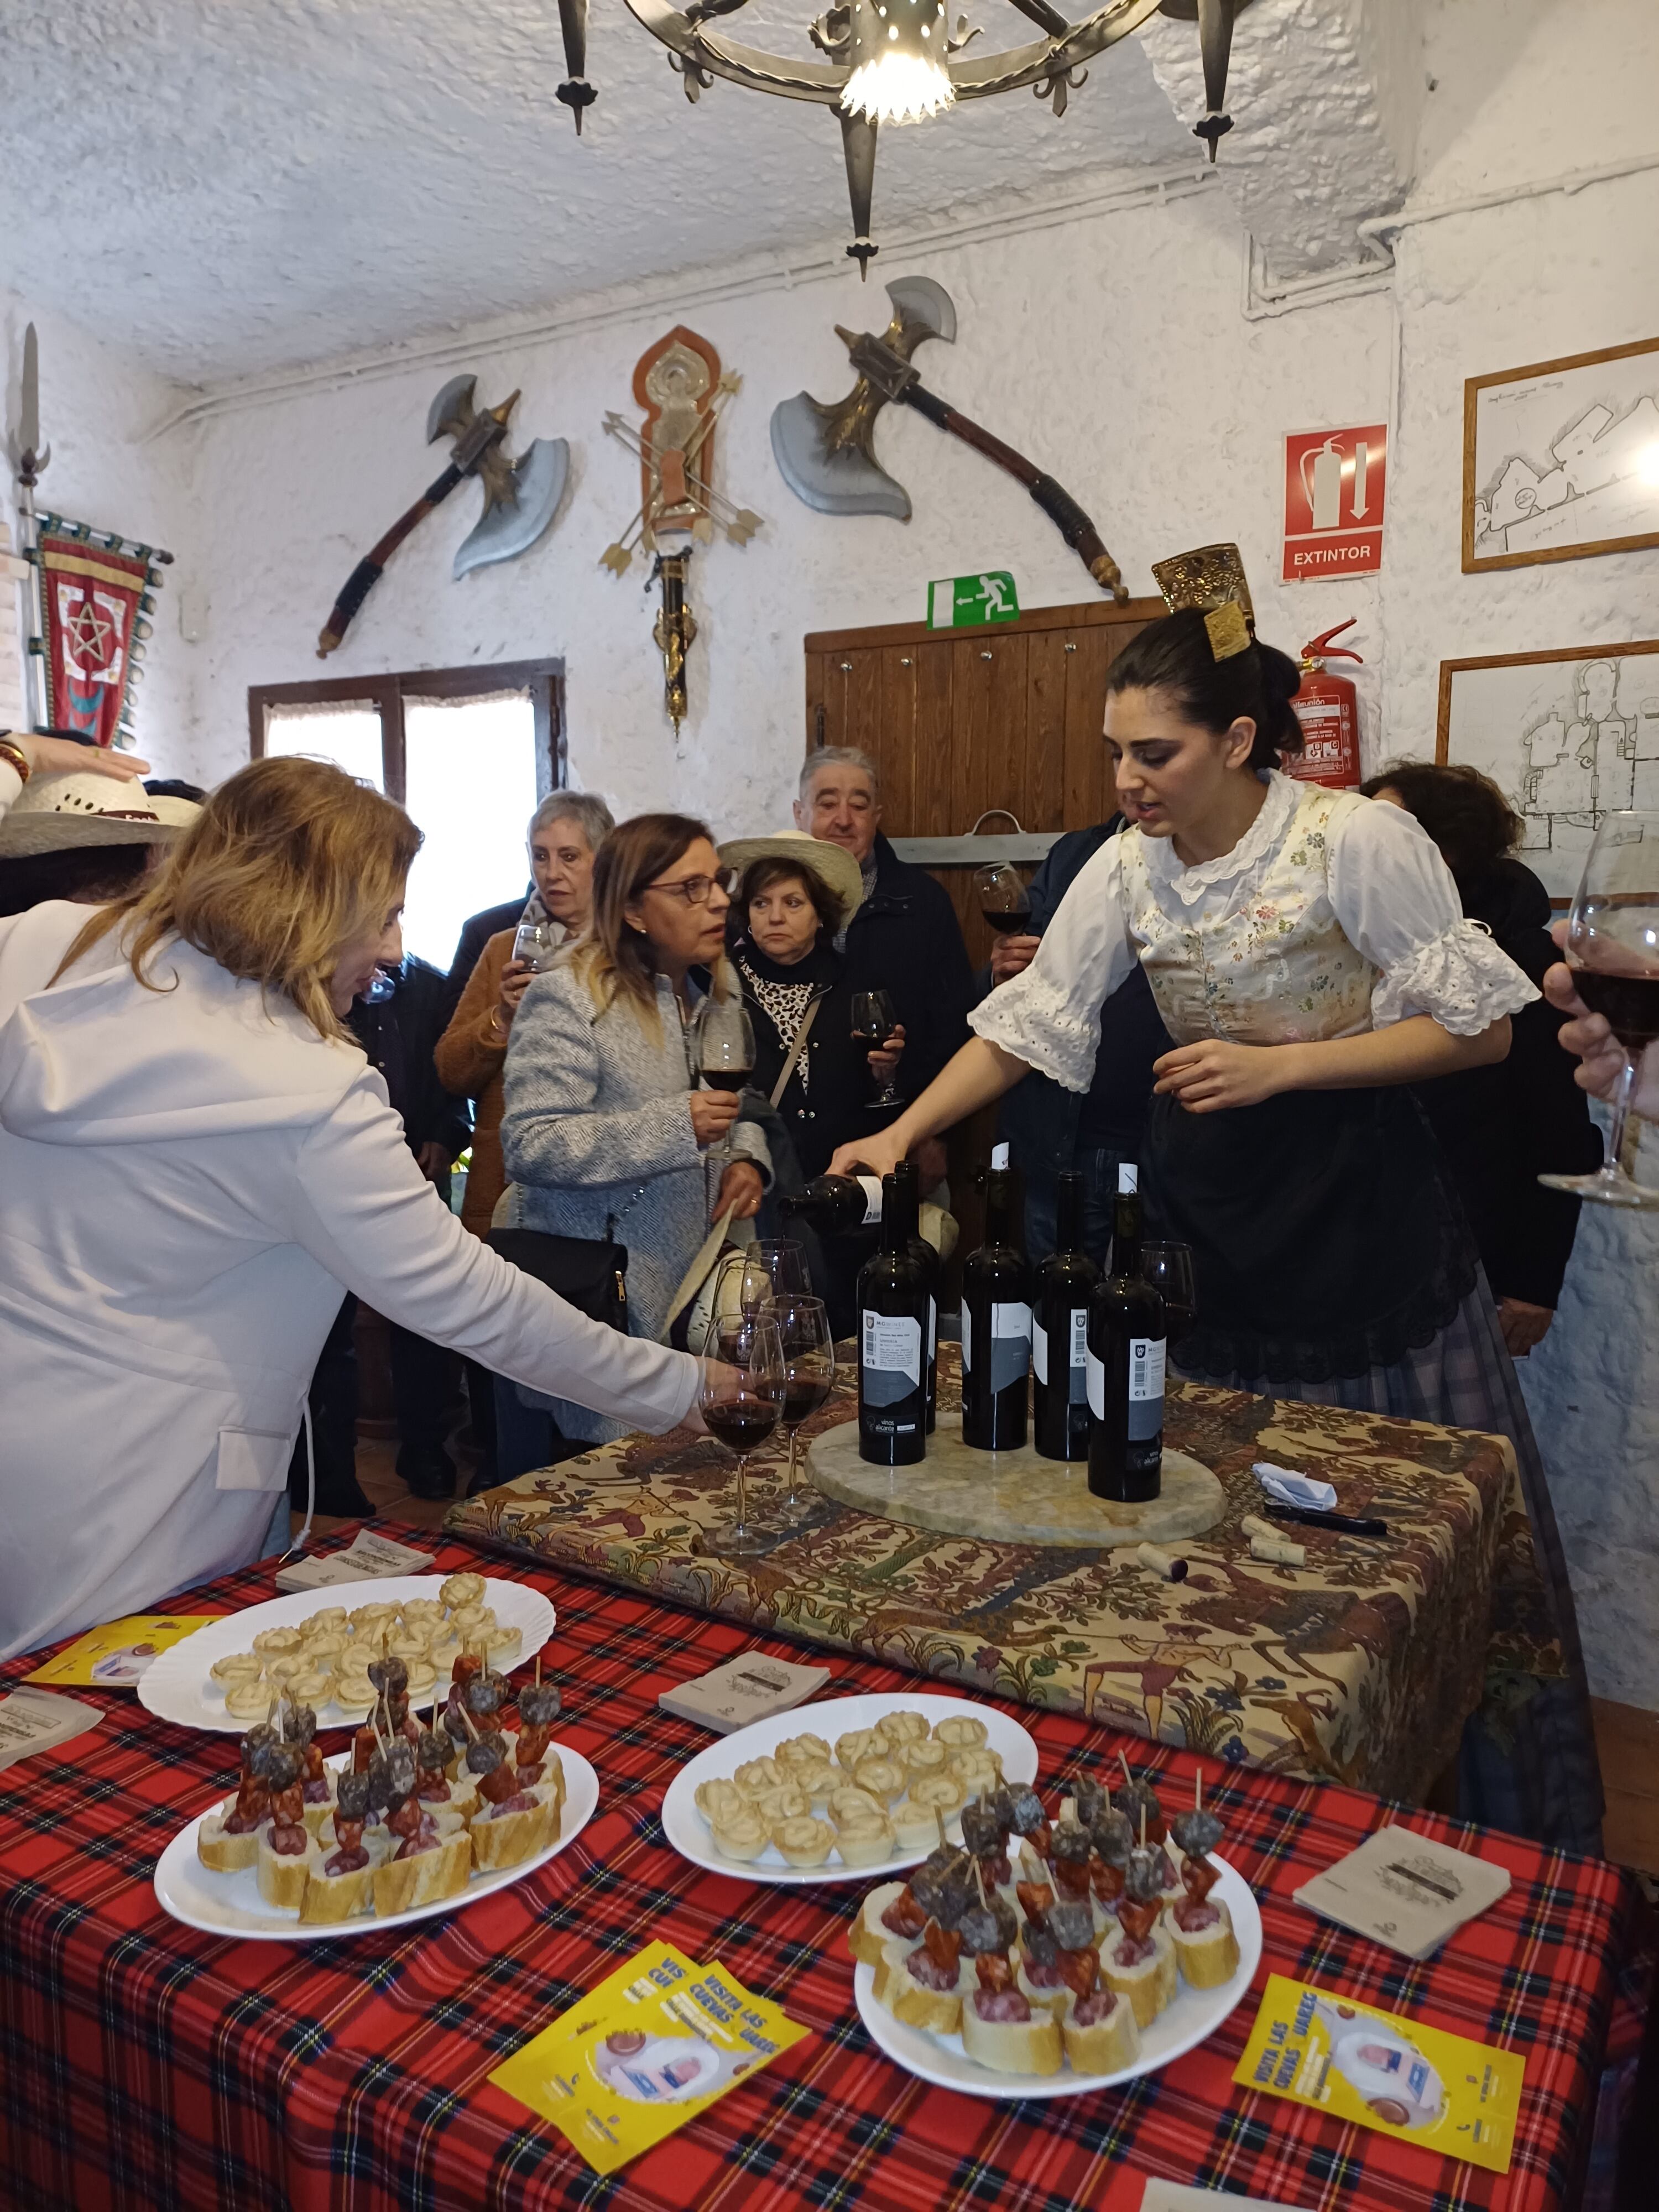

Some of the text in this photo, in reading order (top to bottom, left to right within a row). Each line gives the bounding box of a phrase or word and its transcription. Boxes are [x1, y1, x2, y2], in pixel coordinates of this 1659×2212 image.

[1294, 545, 1370, 565] EXTINTOR
[661, 1957, 686, 1979] VIS
[689, 1983, 734, 2023] CUEVAS
[704, 1973, 744, 2011] VISITA
[740, 2008, 768, 2028] LAS
[1253, 2020, 1289, 2083] VISITA LAS
[1273, 2047, 1301, 2090] CUEVAS
